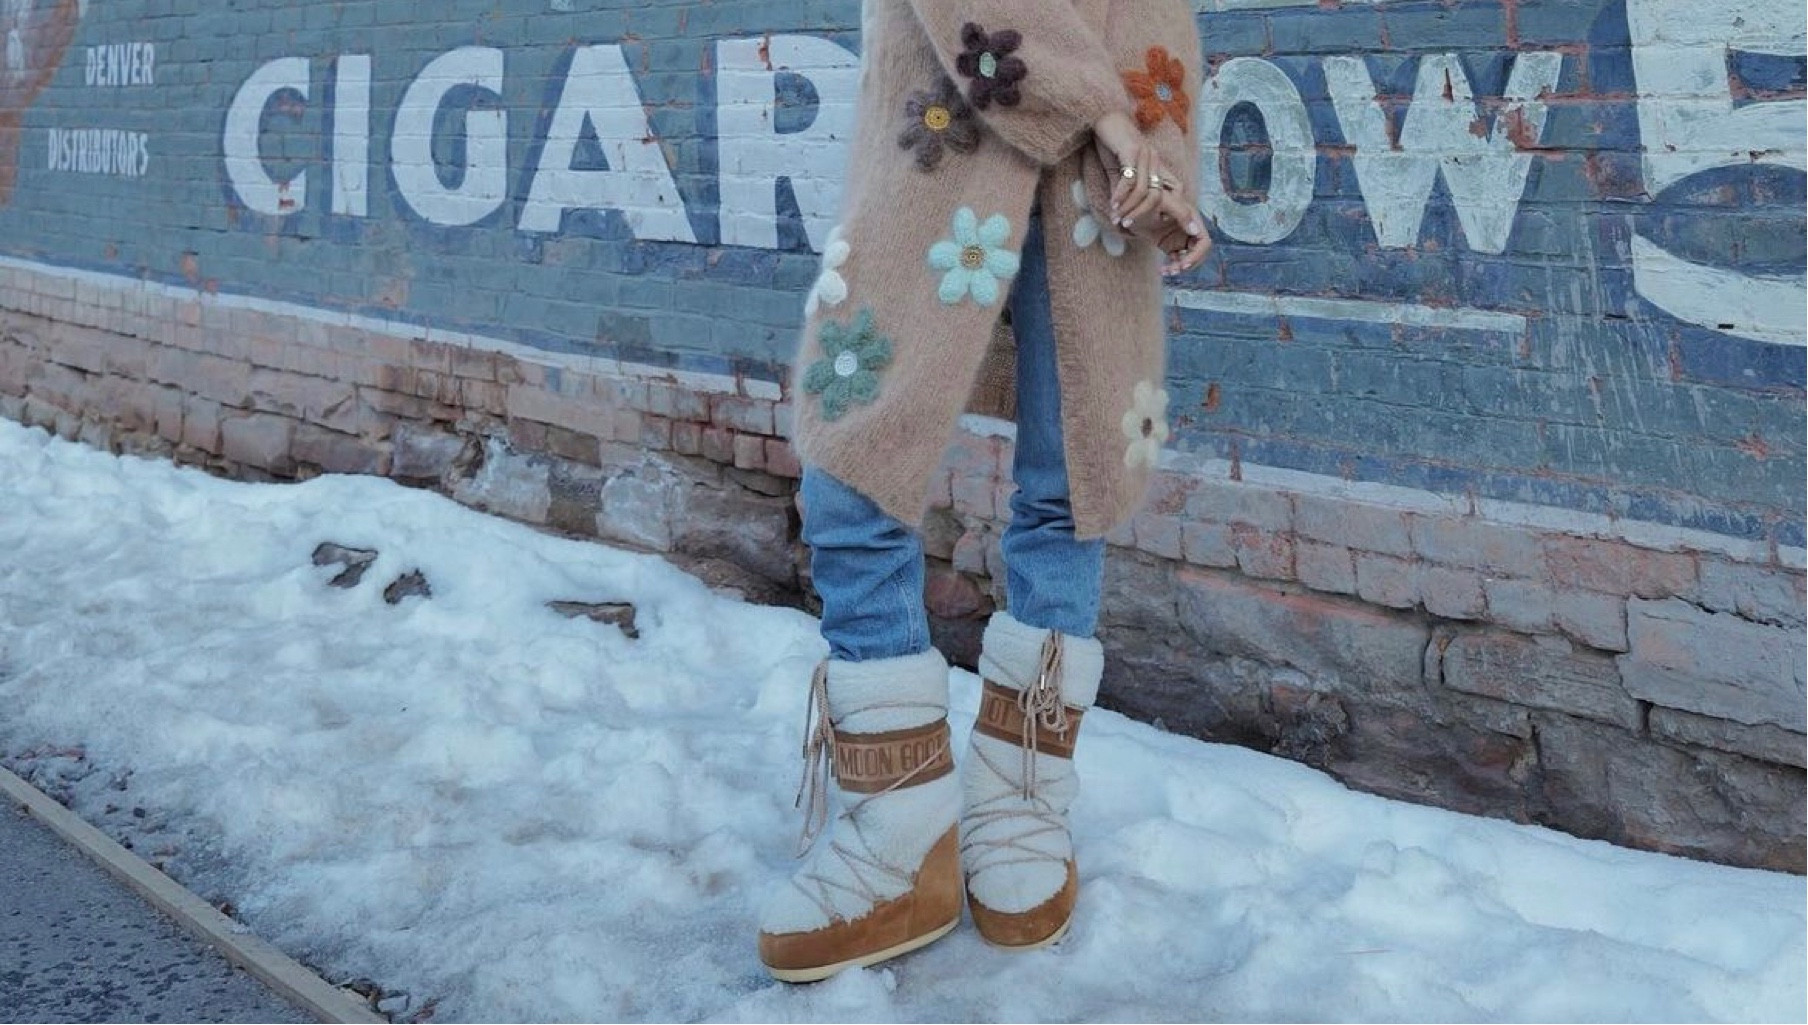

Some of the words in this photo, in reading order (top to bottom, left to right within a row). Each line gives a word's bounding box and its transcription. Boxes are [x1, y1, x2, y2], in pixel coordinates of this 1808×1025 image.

[85, 42, 154, 86] DENVER
[48, 128, 149, 175] DISTRIBUTORS
[840, 746, 893, 776] MOON
